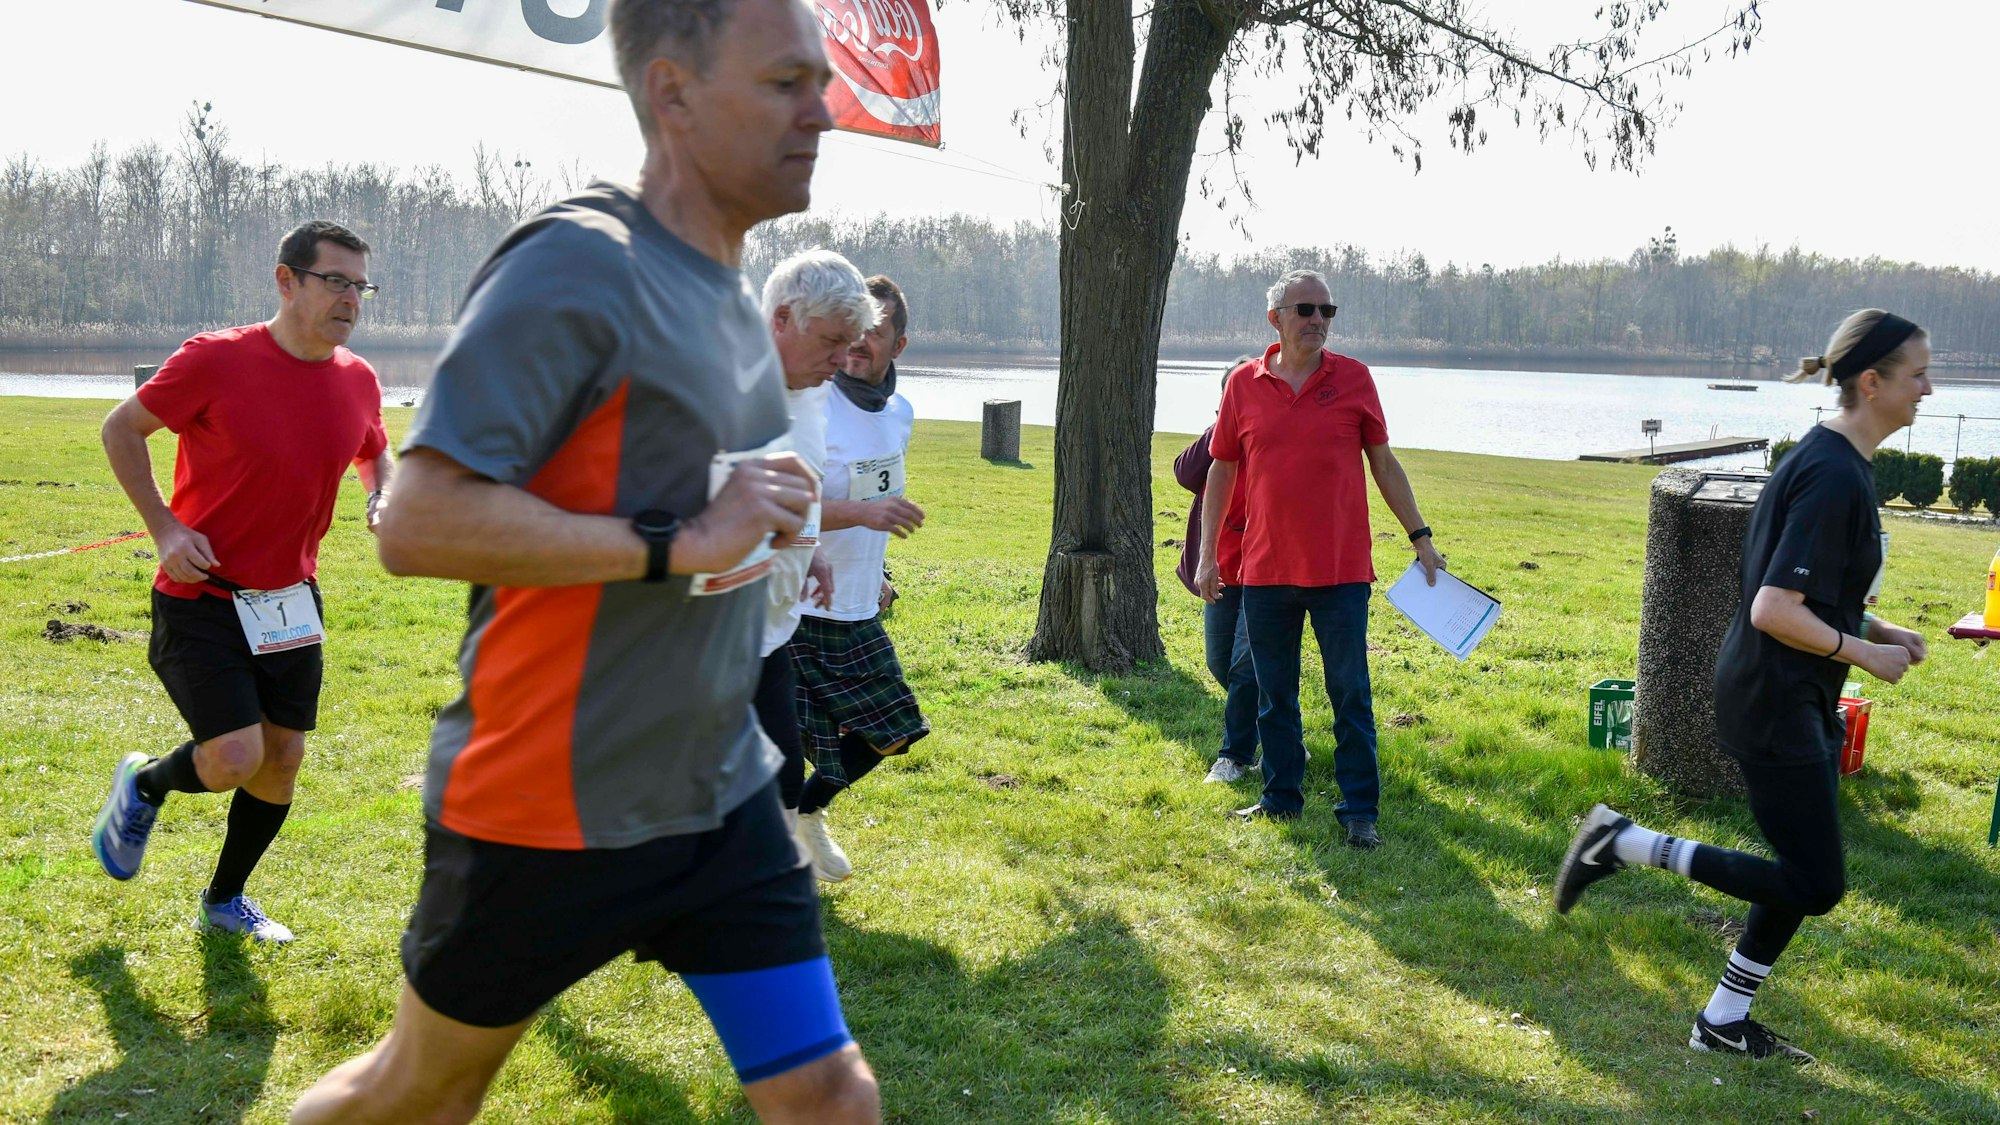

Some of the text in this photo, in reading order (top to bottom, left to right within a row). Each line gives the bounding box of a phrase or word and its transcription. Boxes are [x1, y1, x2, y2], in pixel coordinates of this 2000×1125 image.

[878, 470, 890, 493] 3
[276, 601, 287, 627] 1
[1594, 700, 1603, 726] EIFEL
